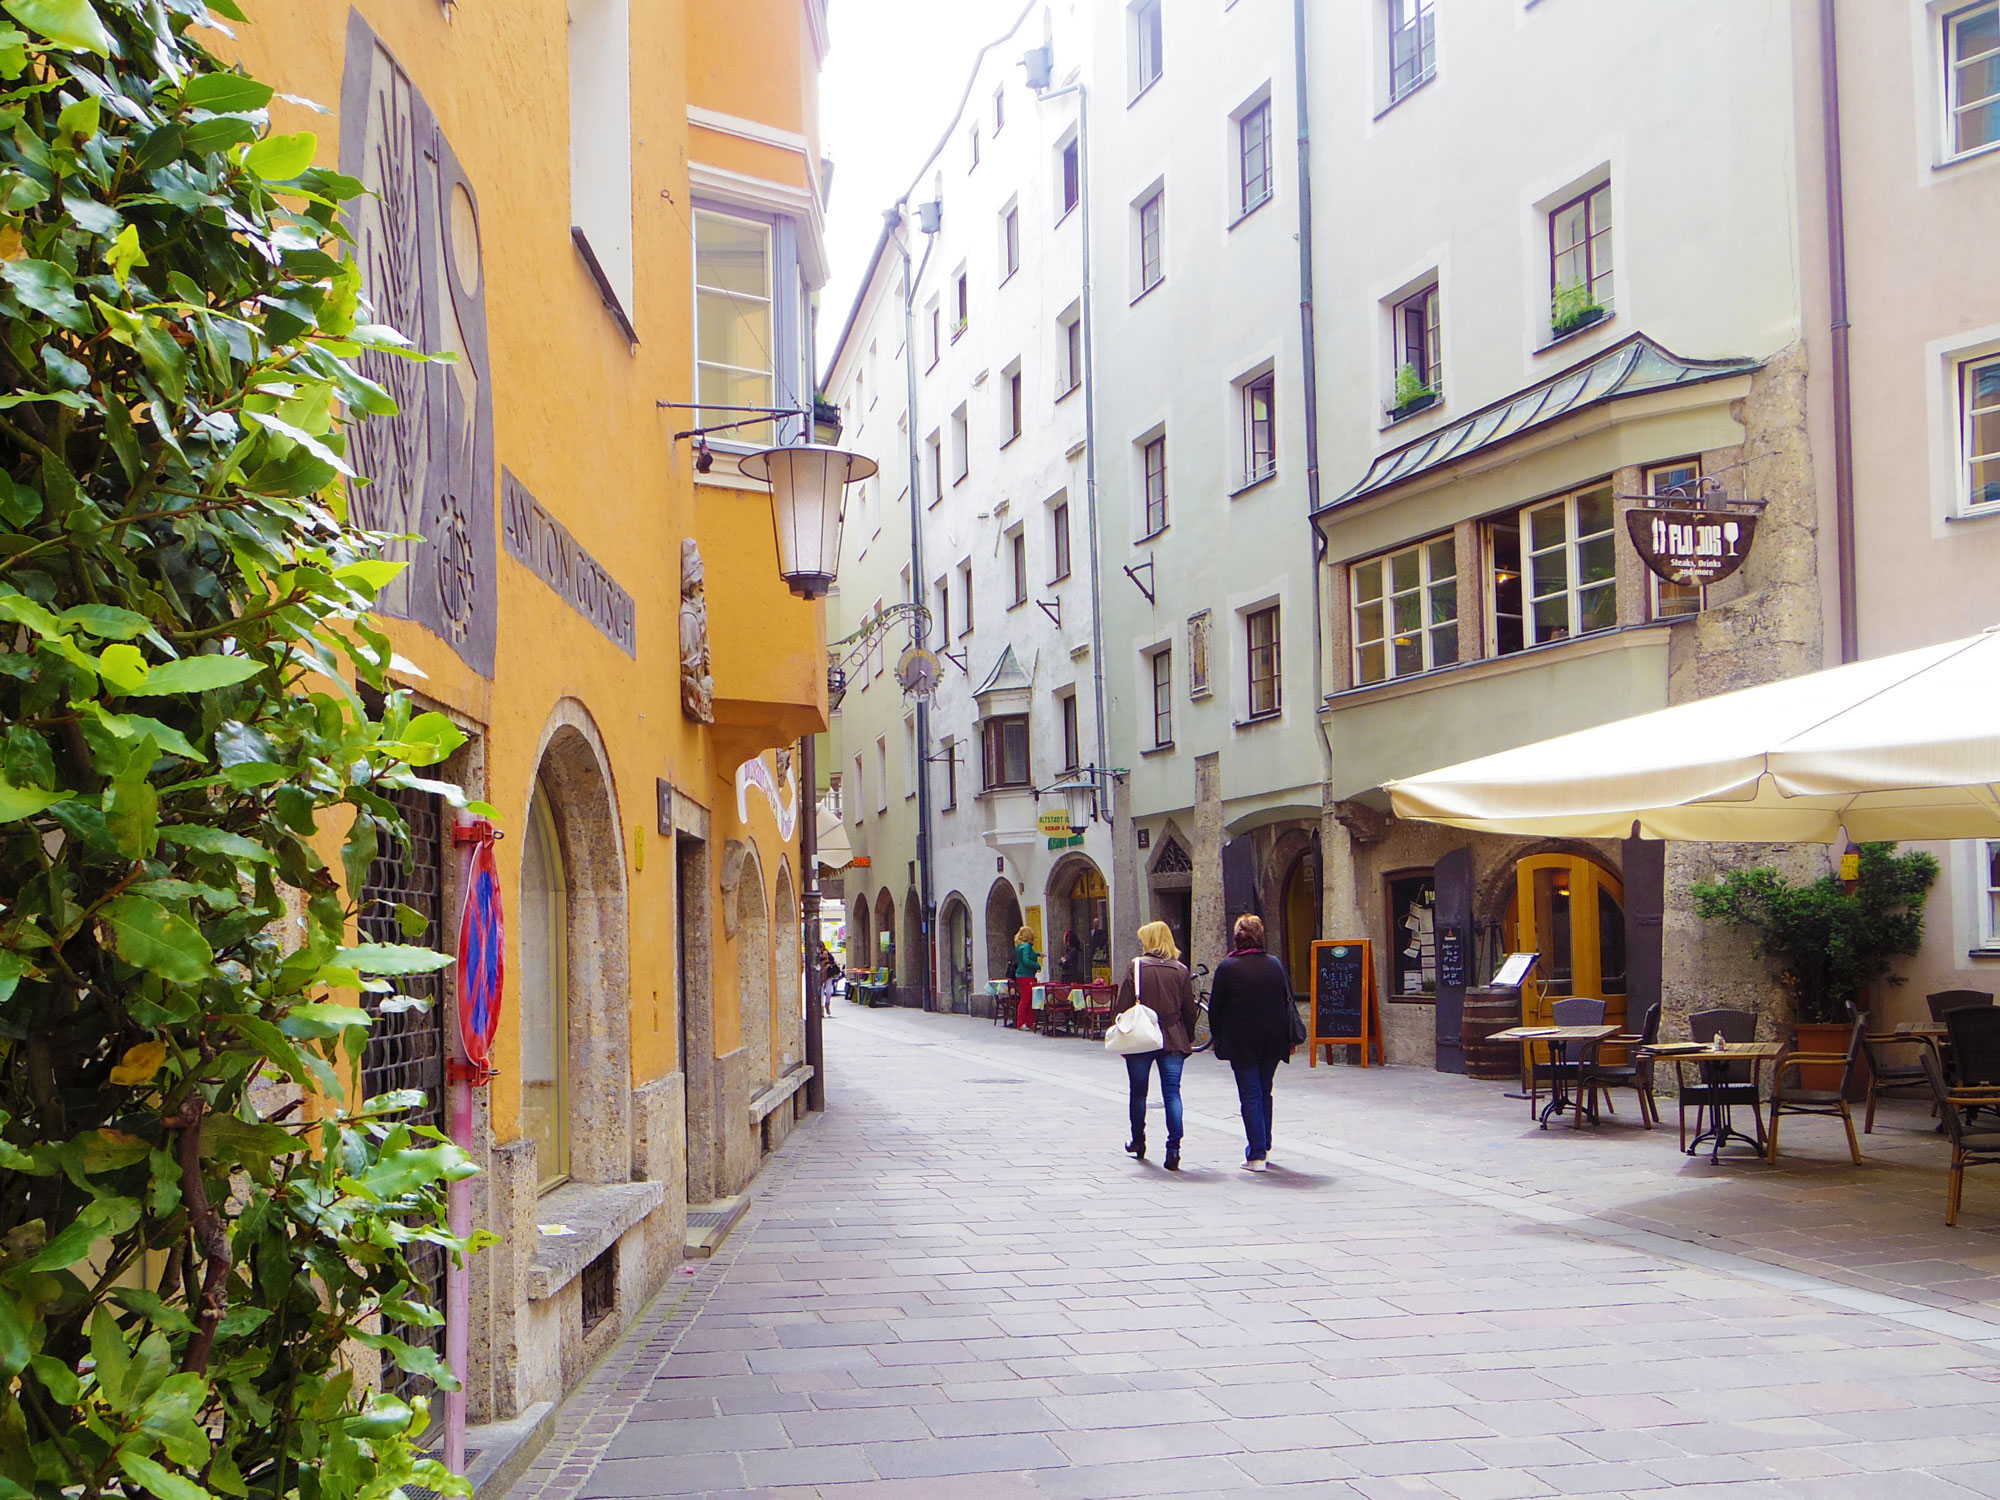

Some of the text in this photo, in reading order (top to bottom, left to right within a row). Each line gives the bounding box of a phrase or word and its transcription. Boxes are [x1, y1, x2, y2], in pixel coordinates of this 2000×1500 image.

[1668, 524, 1722, 556] FLO JOS
[506, 484, 571, 598] ANTON
[575, 551, 634, 651] GÖTSCH
[1670, 558, 1722, 568] Steaks, Drinks
[1679, 568, 1694, 576] and
